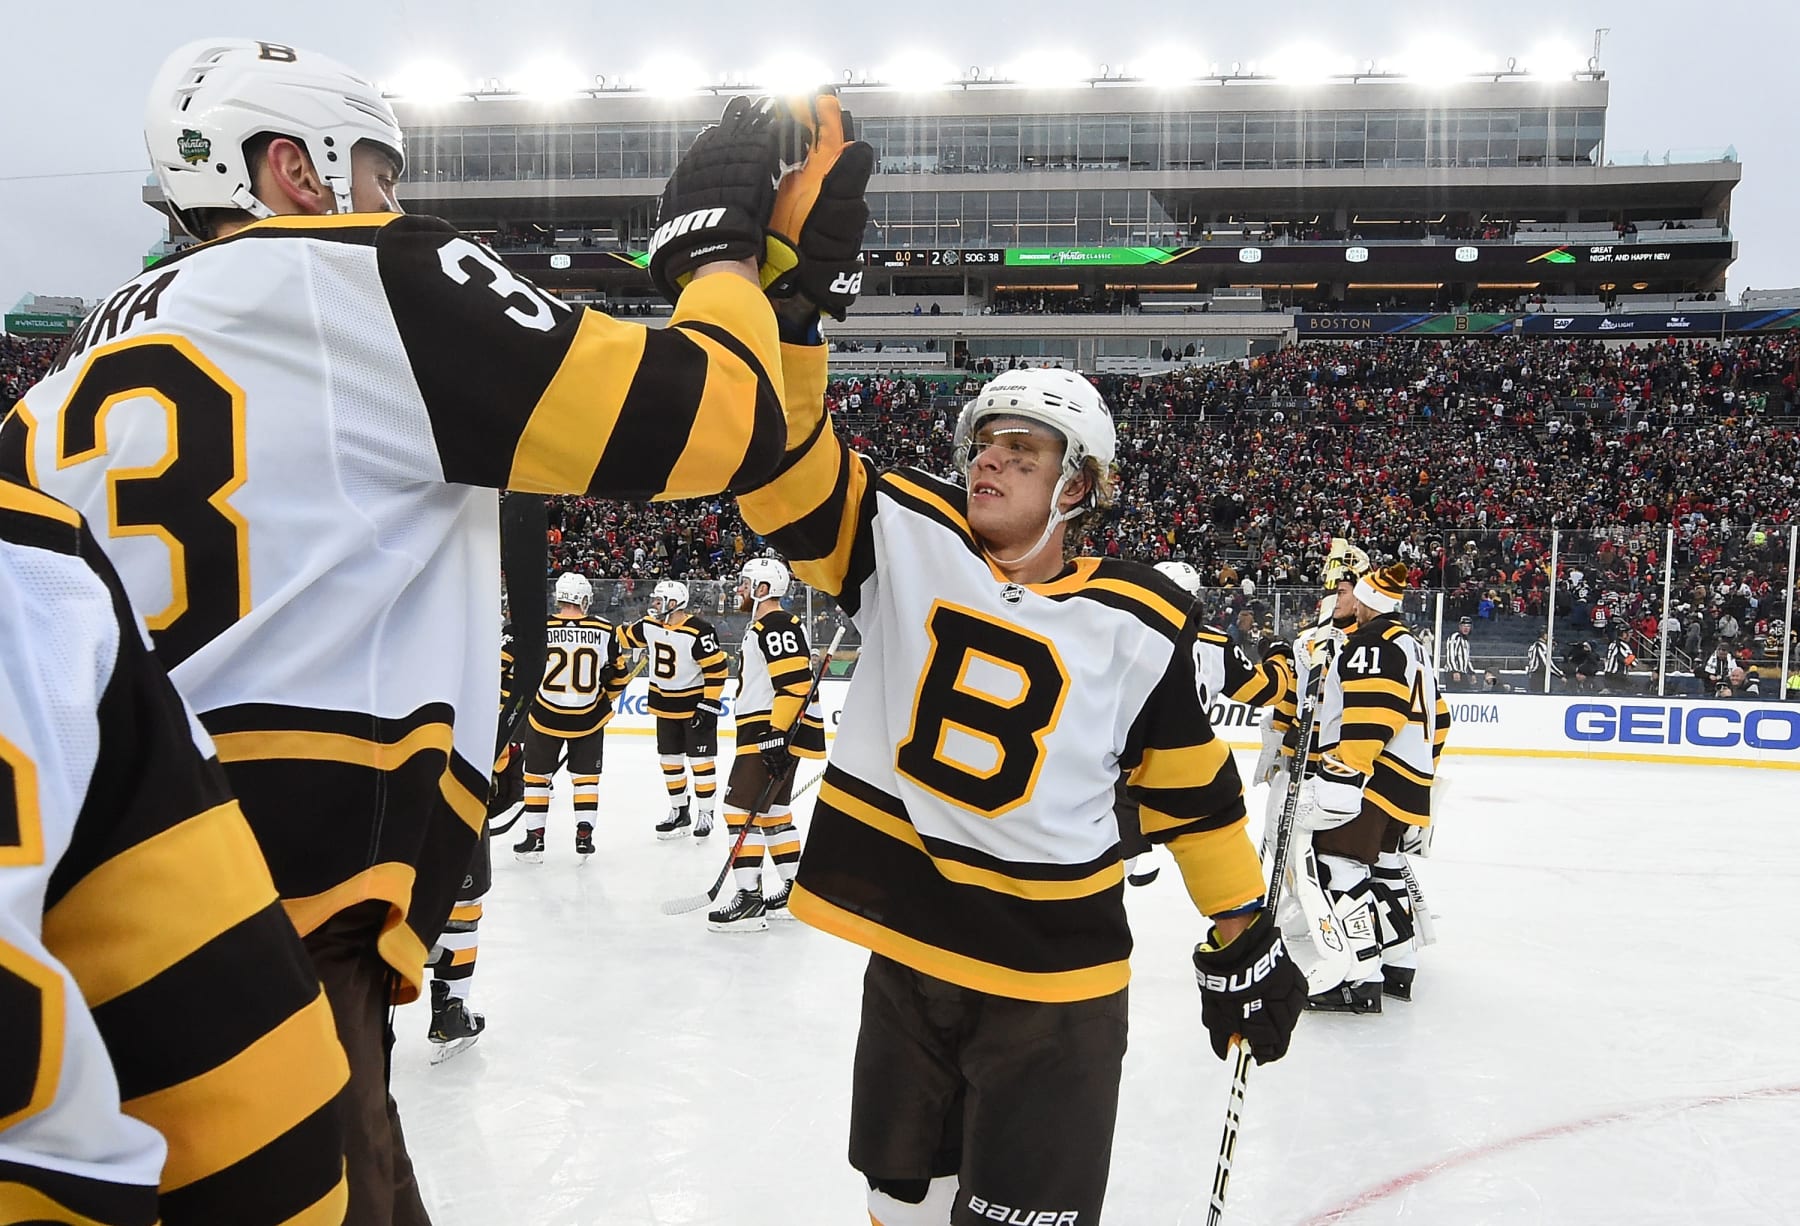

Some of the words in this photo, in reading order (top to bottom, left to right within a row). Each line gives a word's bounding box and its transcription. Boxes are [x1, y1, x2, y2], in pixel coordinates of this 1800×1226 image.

[255, 40, 298, 63] B
[690, 243, 728, 258] CHARA
[895, 251, 911, 262] 0.0
[931, 252, 941, 265] 2
[965, 253, 986, 262] SOG:
[988, 253, 999, 262] 38
[1590, 246, 1613, 254] GREAT
[437, 237, 573, 332] 3
[1310, 318, 1371, 329] BOSTON
[1455, 315, 1469, 331] B
[1554, 319, 1571, 329] SAP
[1595, 611, 1605, 620] 81
[766, 631, 799, 656] 86
[542, 646, 600, 694] 20
[653, 641, 677, 680] B
[1346, 645, 1381, 674] 41
[894, 598, 1072, 819] B
[1451, 703, 1499, 724] VODKA
[1564, 703, 1800, 750] GEICO
[1400, 865, 1424, 903] VAUGHN
[1353, 919, 1367, 930] 41
[967, 1195, 1079, 1226] BAUER
